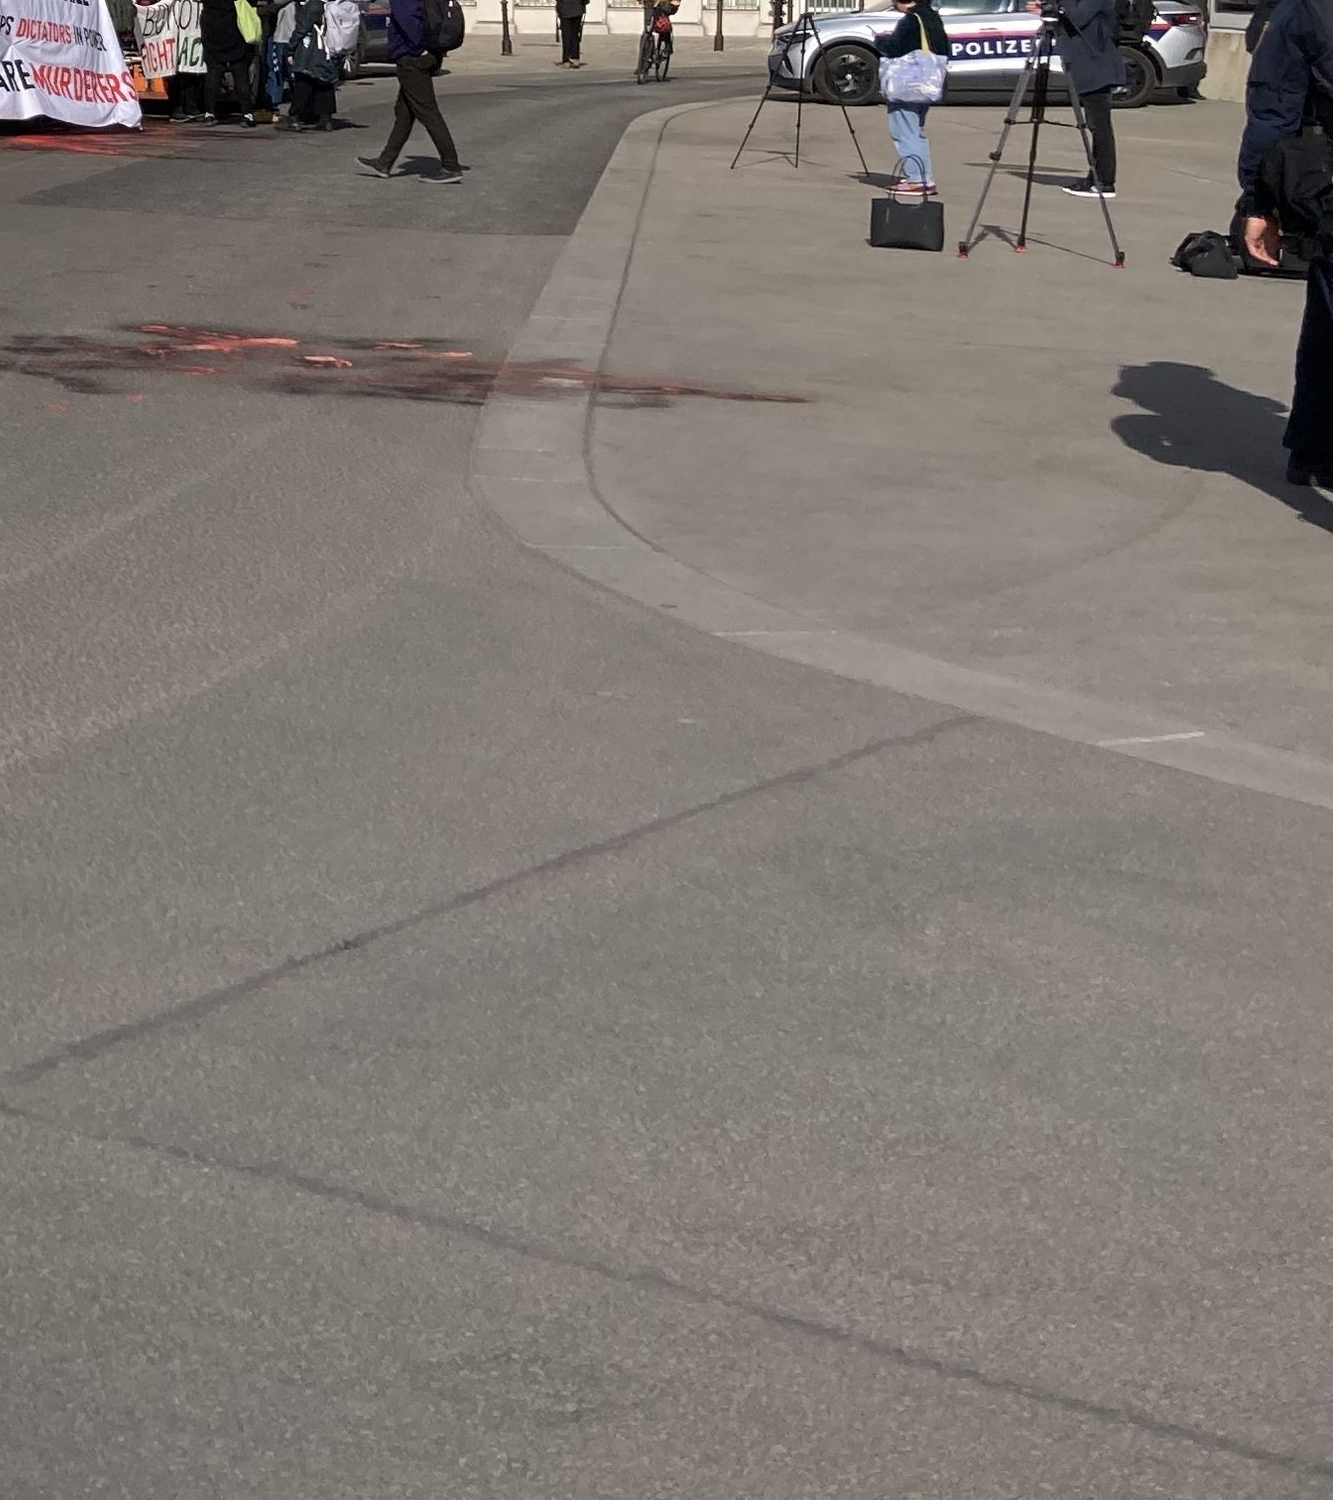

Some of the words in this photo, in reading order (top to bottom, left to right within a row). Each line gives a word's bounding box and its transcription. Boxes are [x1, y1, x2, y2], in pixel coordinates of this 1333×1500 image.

[16, 18, 72, 45] DICTATORS
[73, 26, 83, 46] IN
[30, 62, 140, 106] MURDERERS
